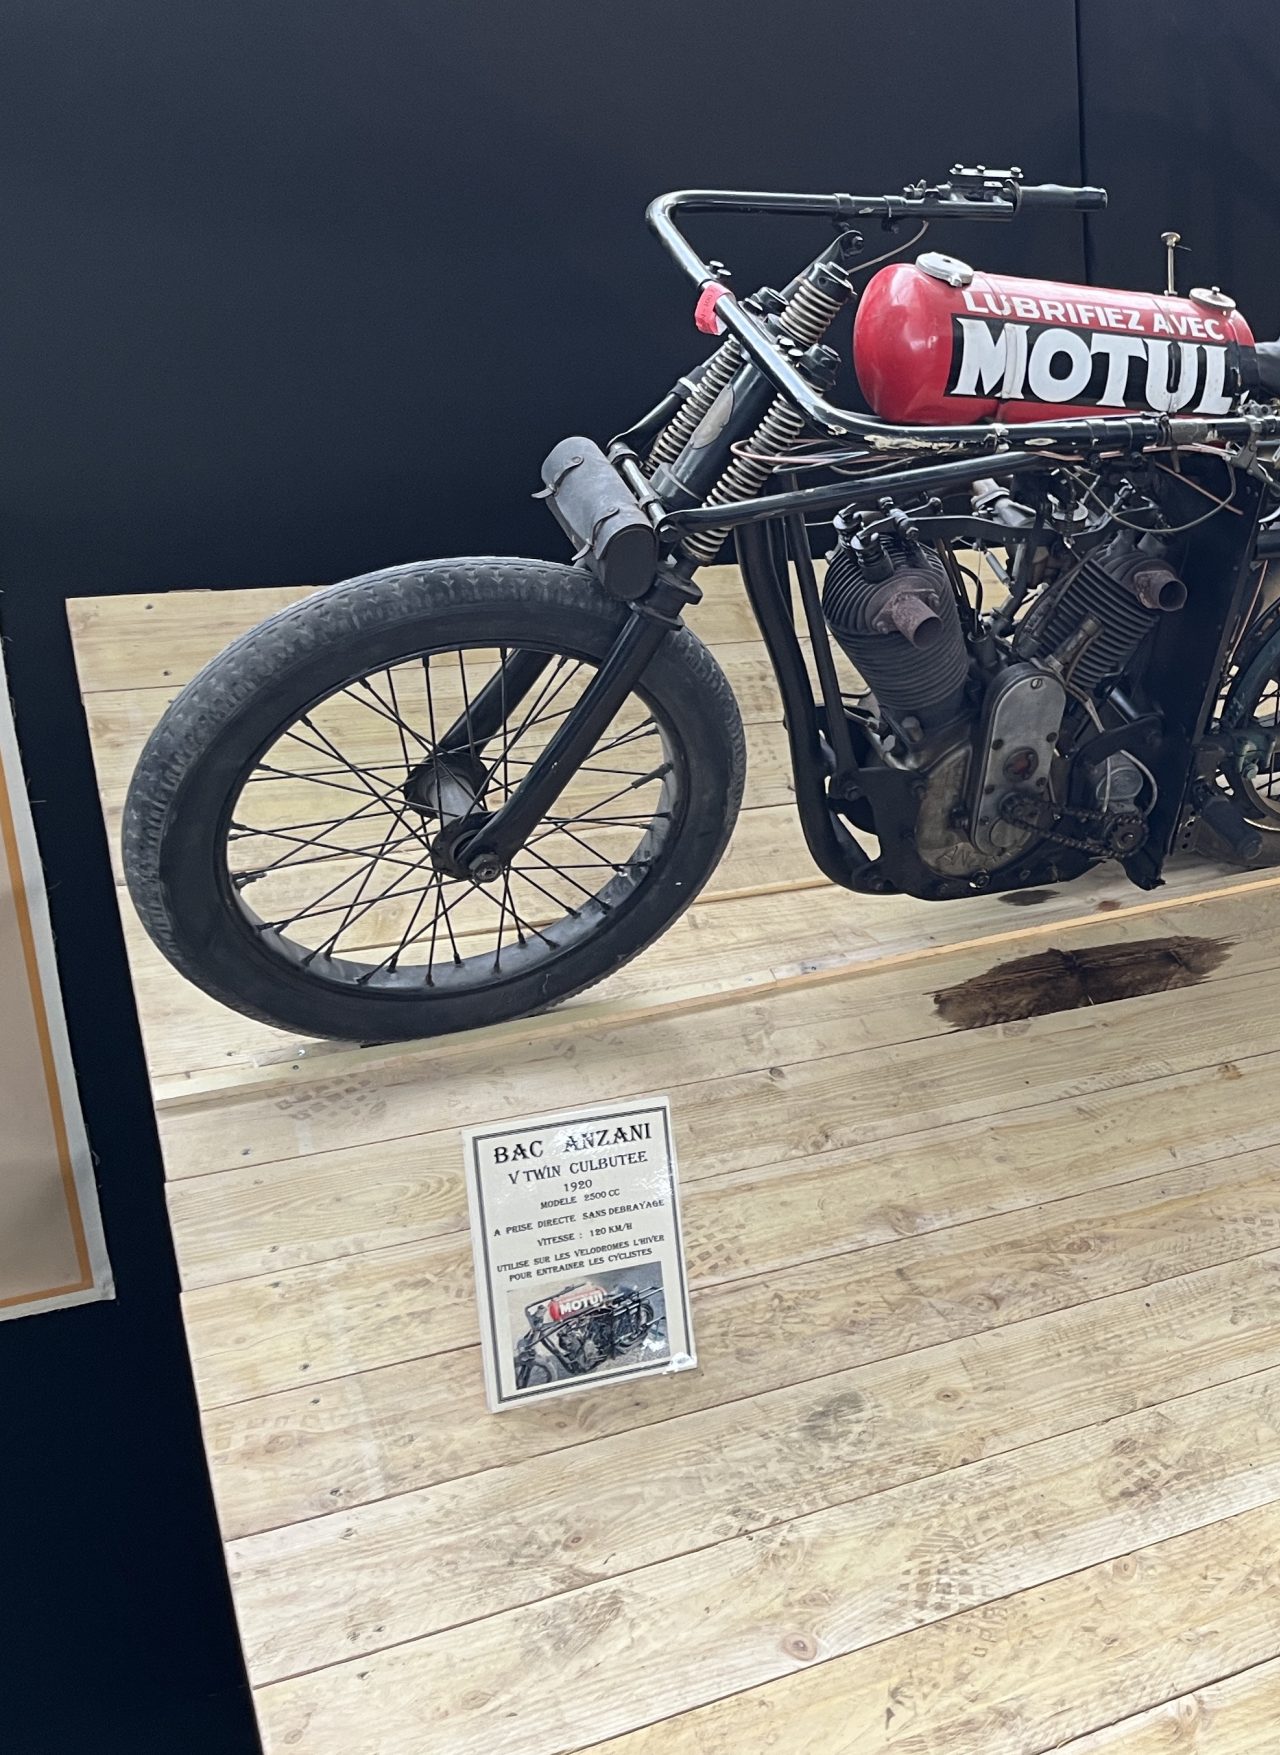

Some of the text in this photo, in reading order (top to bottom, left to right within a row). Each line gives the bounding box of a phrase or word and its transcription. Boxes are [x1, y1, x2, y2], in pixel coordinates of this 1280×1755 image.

[961, 290, 1226, 342] LUBRIFIEZ AVEC
[950, 316, 1235, 416] MOTUL
[493, 1122, 653, 1165] BAC ANZANI
[508, 1150, 648, 1185] V TWIN CULBUTEE
[540, 1188, 621, 1210] MODELE 2500 CC
[563, 1179, 593, 1193] 1920
[493, 1199, 665, 1237] A PRISE DIRECTE SANS DEBRAYAGE
[537, 1232, 576, 1247] VITESSE
[589, 1227, 607, 1238] 120
[608, 1222, 633, 1234] KM/H
[496, 1234, 665, 1273] UTILISE SUR LES VELODROMES L'HIVER
[509, 1247, 653, 1282] POUR ENTRAINER LES CYCLISTES
